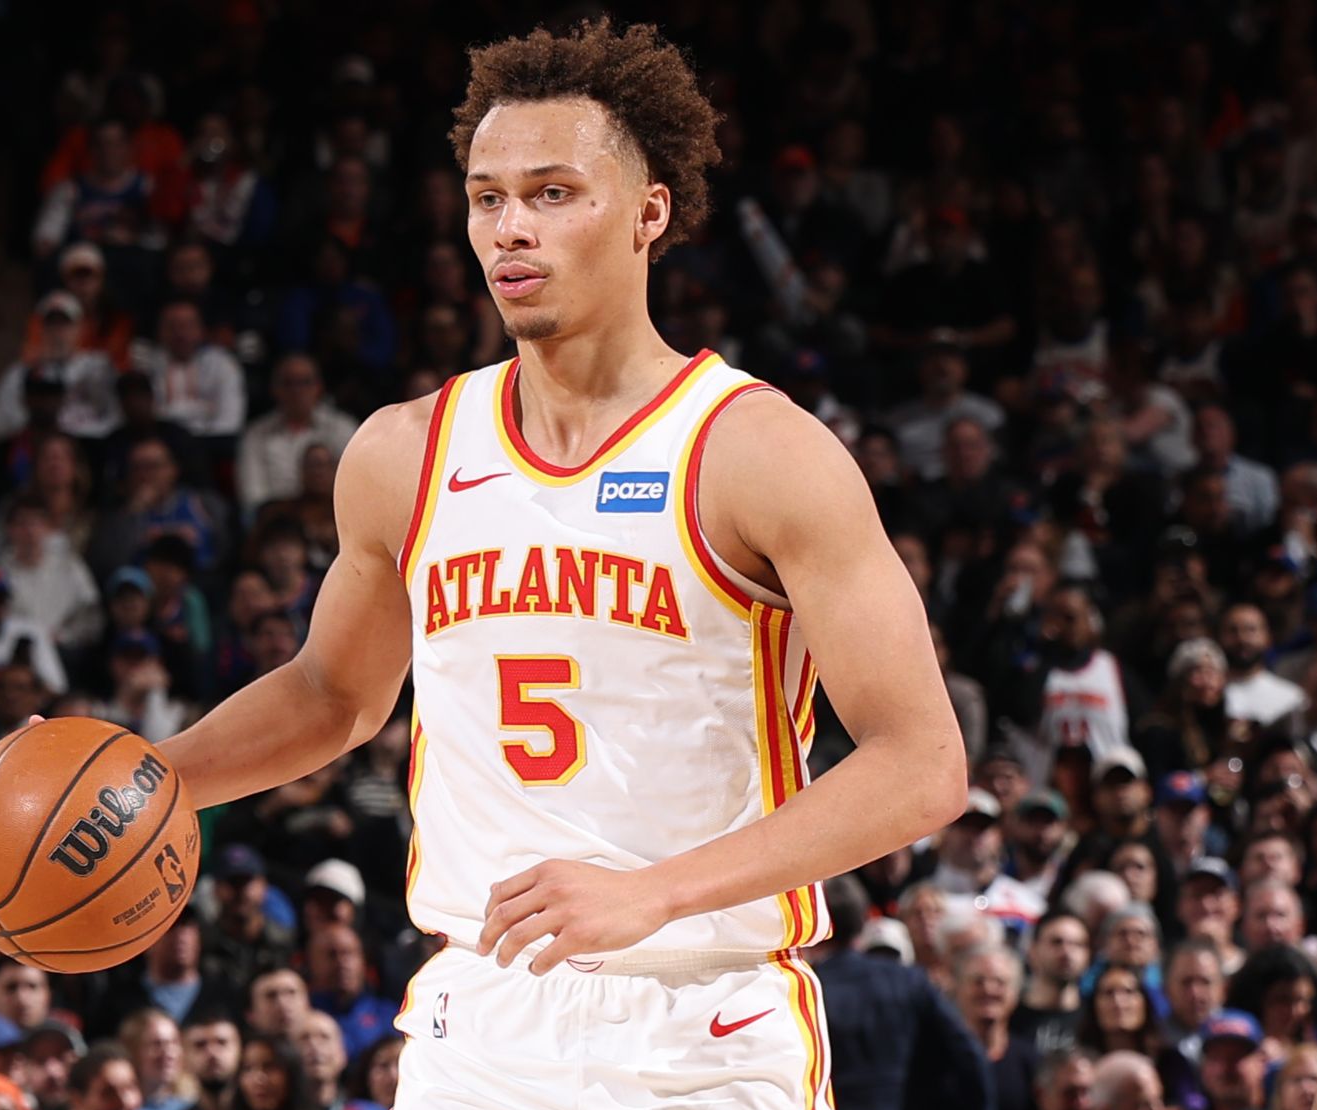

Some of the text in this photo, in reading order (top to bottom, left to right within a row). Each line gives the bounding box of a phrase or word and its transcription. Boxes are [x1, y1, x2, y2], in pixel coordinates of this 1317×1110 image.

[602, 482, 664, 504] paze
[424, 545, 692, 642] ATLANTA
[494, 653, 587, 787] 5
[48, 753, 169, 876] Wilson
